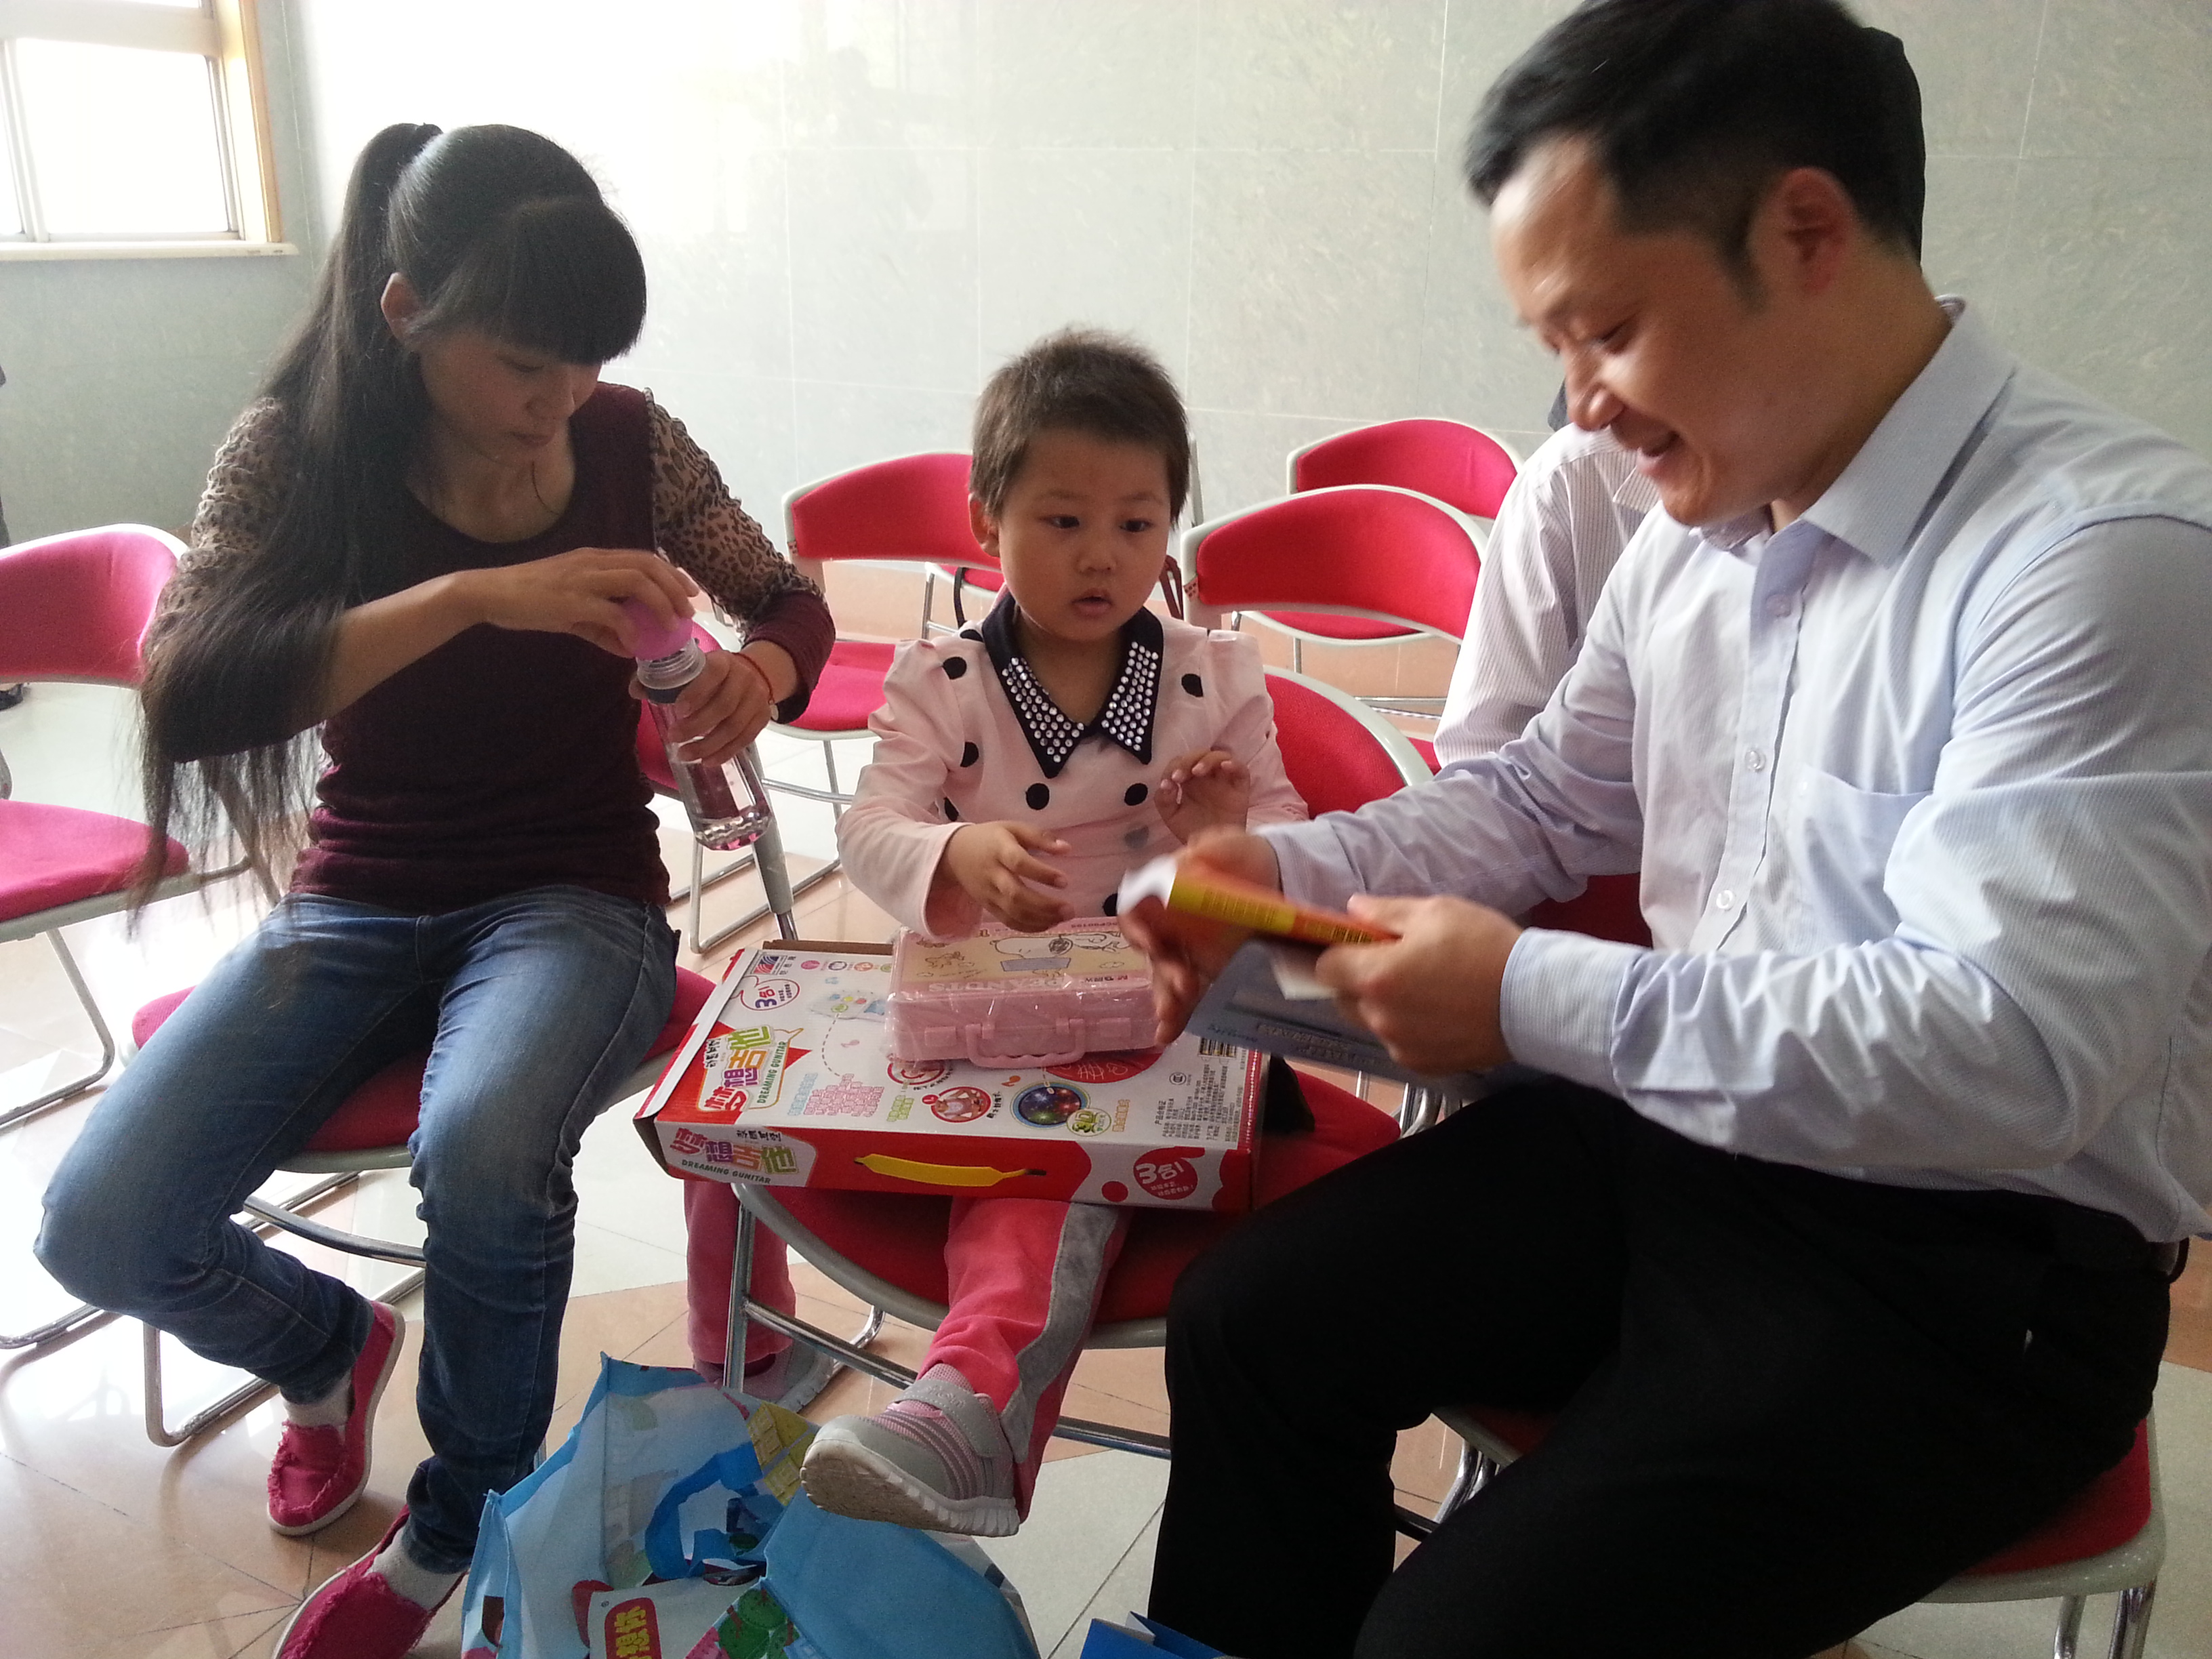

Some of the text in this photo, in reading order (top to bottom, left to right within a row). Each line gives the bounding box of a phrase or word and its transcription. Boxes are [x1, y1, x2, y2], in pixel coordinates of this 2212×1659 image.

[703, 1026, 771, 1111] 梦想吉他
[756, 1041, 788, 1104] DREAMING GUNITAR
[670, 1127, 799, 1174] 梦想吉他
[682, 1159, 772, 1185] DREAMING GUNITAR
[614, 1606, 651, 1659] 想你
